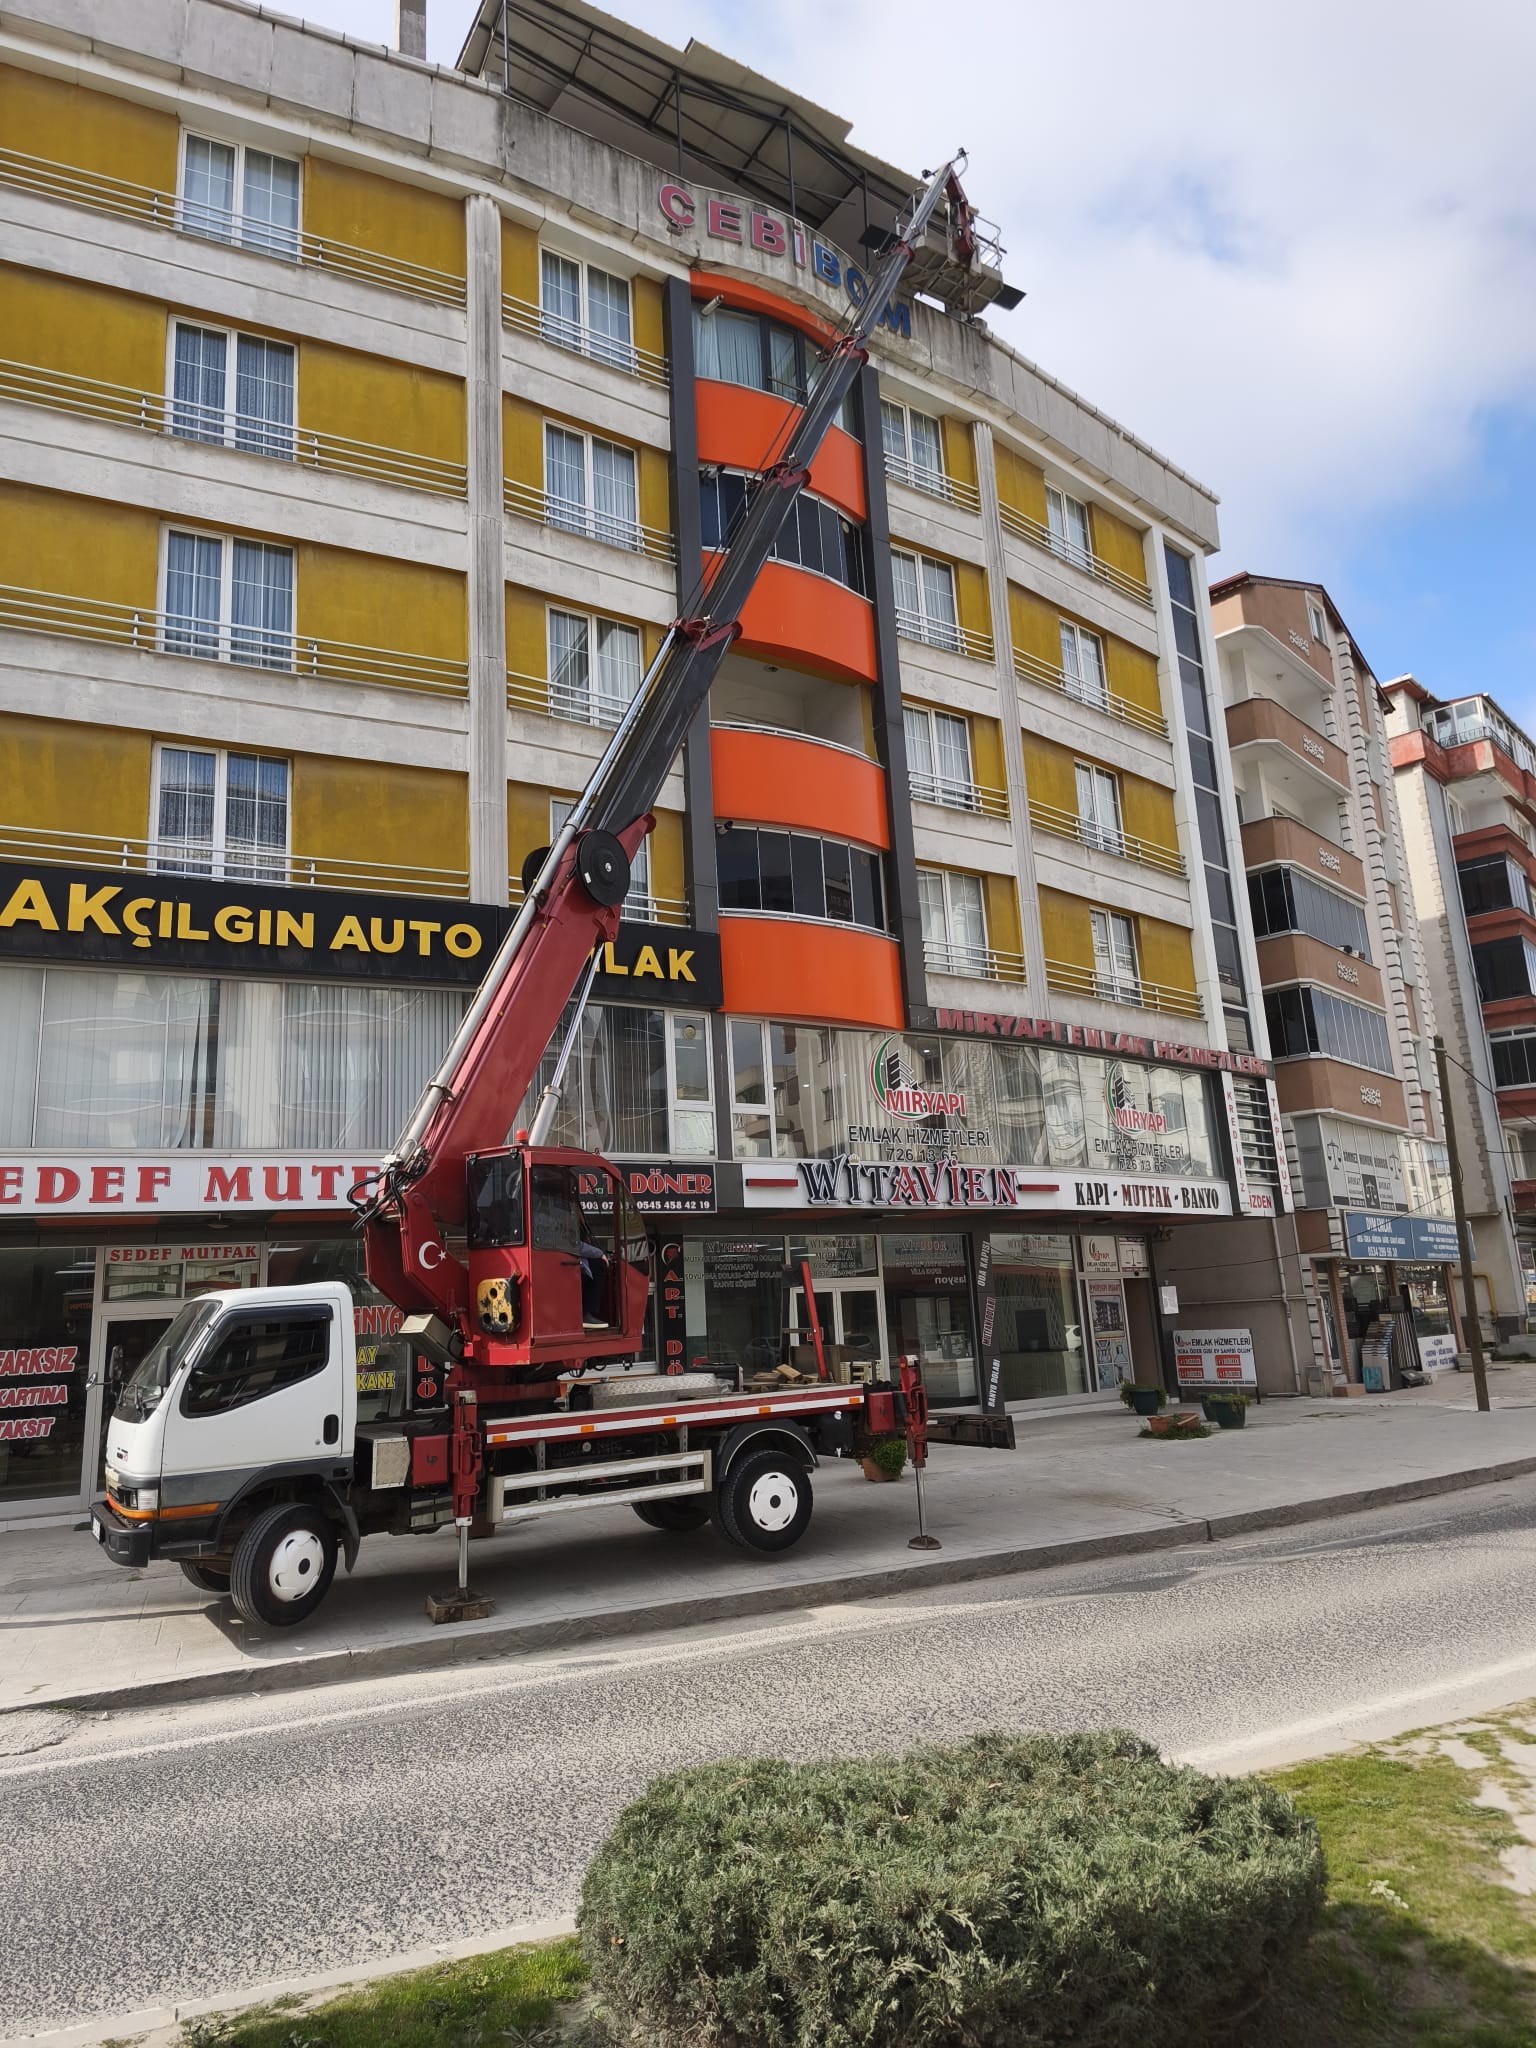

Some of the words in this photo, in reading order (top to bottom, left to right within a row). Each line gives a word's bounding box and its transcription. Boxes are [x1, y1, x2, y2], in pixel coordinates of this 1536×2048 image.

[329, 915, 482, 958] AUTO
[590, 941, 697, 982] LAK
[936, 1007, 1062, 1041] MİRYAPI
[1067, 1023, 1147, 1056] EMLAK
[848, 1125, 902, 1144] EMLAK
[906, 1123, 990, 1147] HİZMETLERİ
[1270, 1098, 1290, 1195] TAPUNUZ
[886, 1148, 914, 1163] 726
[919, 1149, 936, 1163] 13
[940, 1150, 959, 1162] 65
[1094, 1138, 1129, 1158] EMLAK
[0, 1166, 172, 1204] EDEF
[203, 1165, 381, 1202] MUTF
[630, 1168, 713, 1195] DÖNER
[636, 1201, 662, 1210] 0545
[664, 1201, 682, 1210] 458
[684, 1201, 697, 1210] 42
[1075, 1182, 1111, 1206] KAPI
[1121, 1184, 1173, 1208] MUTFAK
[1181, 1187, 1220, 1210] BANYO
[109, 1247, 172, 1263] SEDEF
[181, 1245, 257, 1261] MUTFAK
[977, 1269, 986, 1287] ODA
[1191, 1338, 1213, 1346] EMLAK
[356, 1370, 396, 1392] KANI
